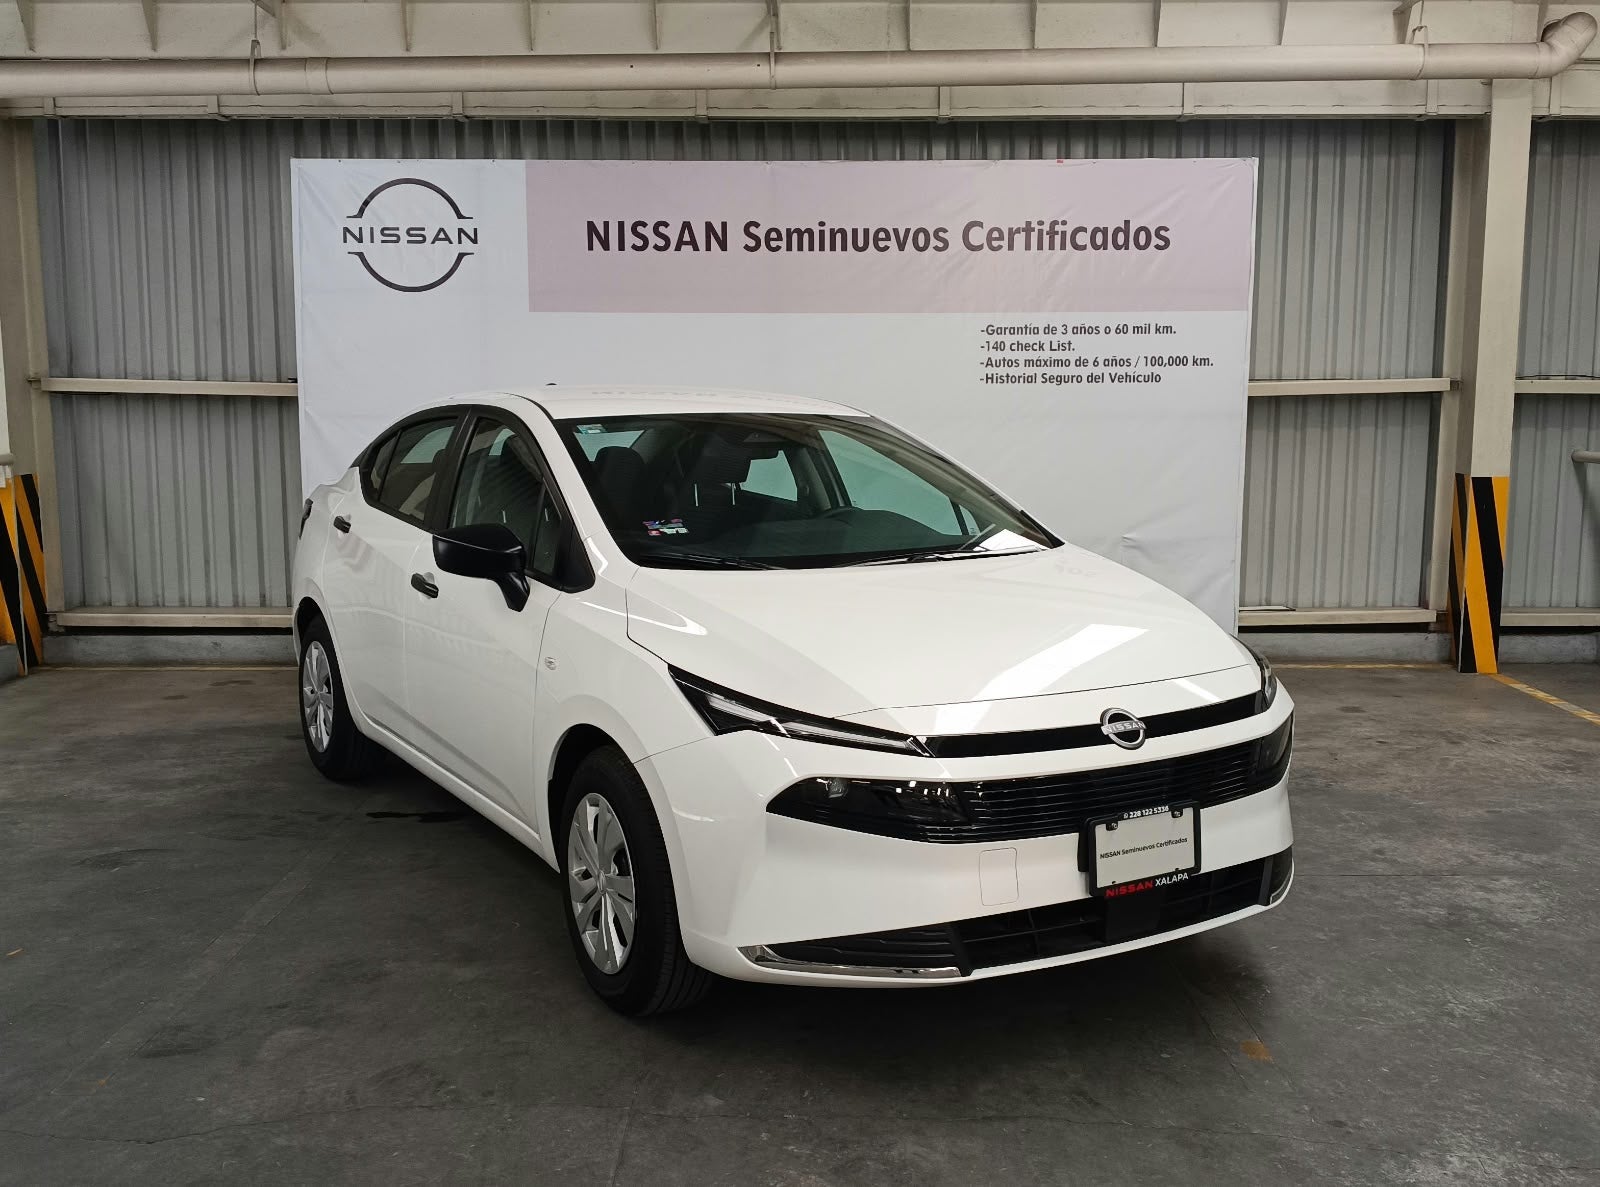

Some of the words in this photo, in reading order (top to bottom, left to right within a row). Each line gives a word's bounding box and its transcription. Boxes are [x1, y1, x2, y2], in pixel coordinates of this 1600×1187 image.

[342, 226, 479, 245] NISSAN
[586, 220, 728, 252] NISSAN
[743, 220, 950, 253] Seminuevos
[962, 219, 1171, 252] Certificados
[1043, 323, 1058, 336] de
[1061, 324, 1069, 336] 3
[1071, 323, 1101, 336] años
[1104, 326, 1112, 335] o
[1114, 324, 1129, 335] 60
[1132, 323, 1151, 335] mil
[1154, 323, 1177, 335] km.
[1009, 340, 1046, 352] check
[1049, 340, 1076, 352] List.
[1023, 356, 1071, 368] máximo
[1074, 356, 1089, 368] de
[1092, 356, 1100, 368] 6
[1103, 355, 1132, 368] años
[1143, 356, 1189, 369] 100,000
[1191, 356, 1214, 367] km.
[1040, 372, 1083, 386] Seguro
[1086, 372, 1105, 384] del
[1108, 372, 1162, 384] Vehículo
[1104, 720, 1146, 734] NISSAN
[1129, 810, 1142, 819] 228
[1142, 808, 1153, 816] 122
[1099, 850, 1121, 859] NISSAN
[1121, 843, 1156, 855] Seminuevos
[1155, 837, 1188, 849] Certificados
[1105, 880, 1154, 897] NISSAN
[1154, 872, 1189, 887] XALAPA
